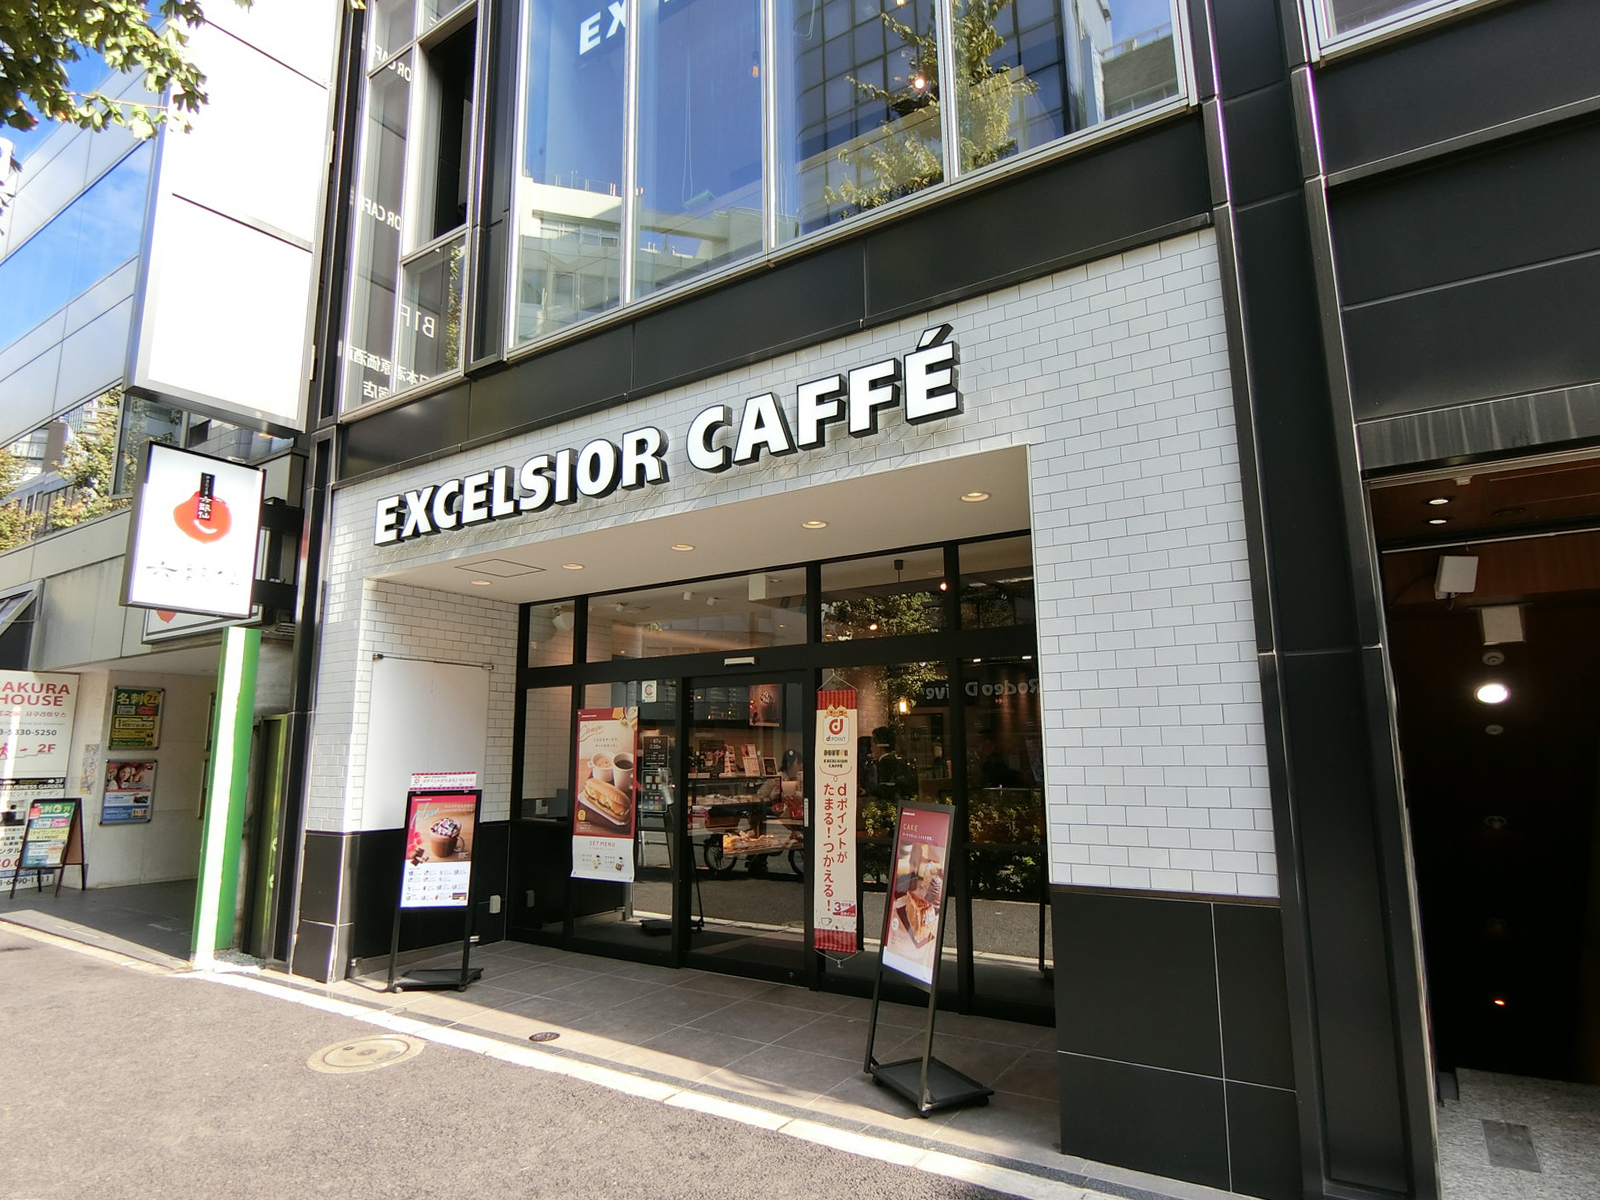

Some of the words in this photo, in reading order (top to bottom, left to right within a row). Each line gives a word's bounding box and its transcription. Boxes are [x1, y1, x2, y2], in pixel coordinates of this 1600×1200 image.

[374, 425, 669, 546] EXCELSIOR
[686, 324, 964, 473] CAFFÉ
[0, 681, 70, 695] AKURA
[117, 692, 144, 705] 名刺
[38, 743, 56, 753] 2F
[837, 783, 848, 864] dポイントが
[903, 823, 918, 831] CAKE
